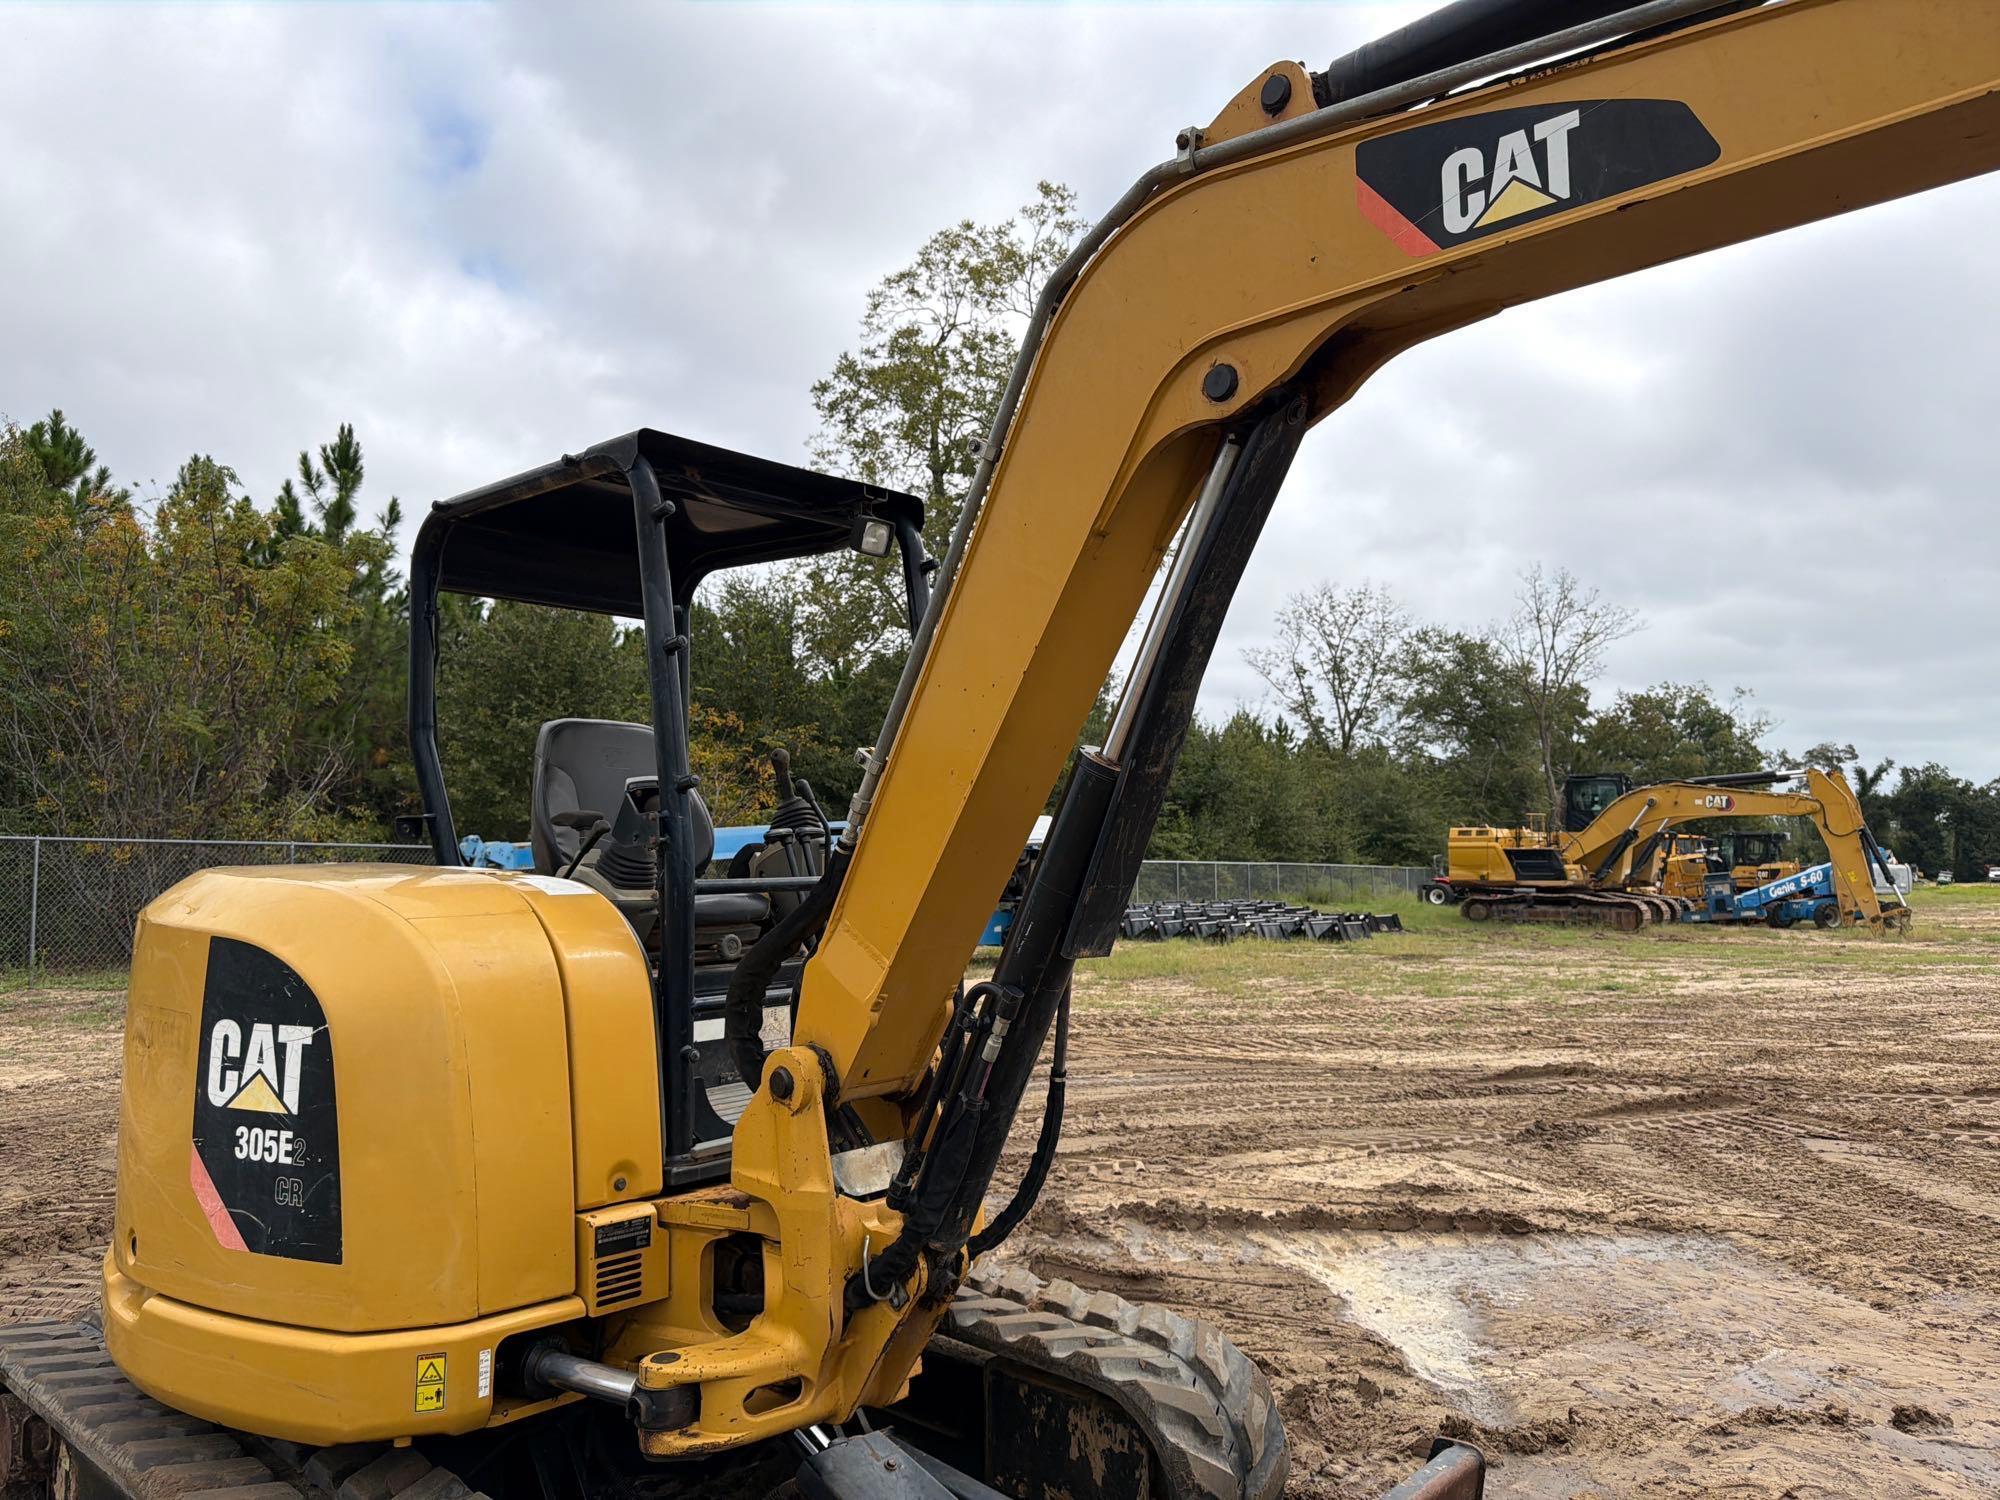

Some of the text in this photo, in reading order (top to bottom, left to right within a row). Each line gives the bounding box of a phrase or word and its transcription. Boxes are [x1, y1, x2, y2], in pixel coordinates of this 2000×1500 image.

[1442, 109, 1580, 234] CAT
[1705, 795, 1728, 809] CAT
[1769, 870, 1824, 898] Genie S-60
[207, 1018, 314, 1115] CAT
[234, 1125, 306, 1167] 305E2
[274, 1176, 303, 1207] CR
